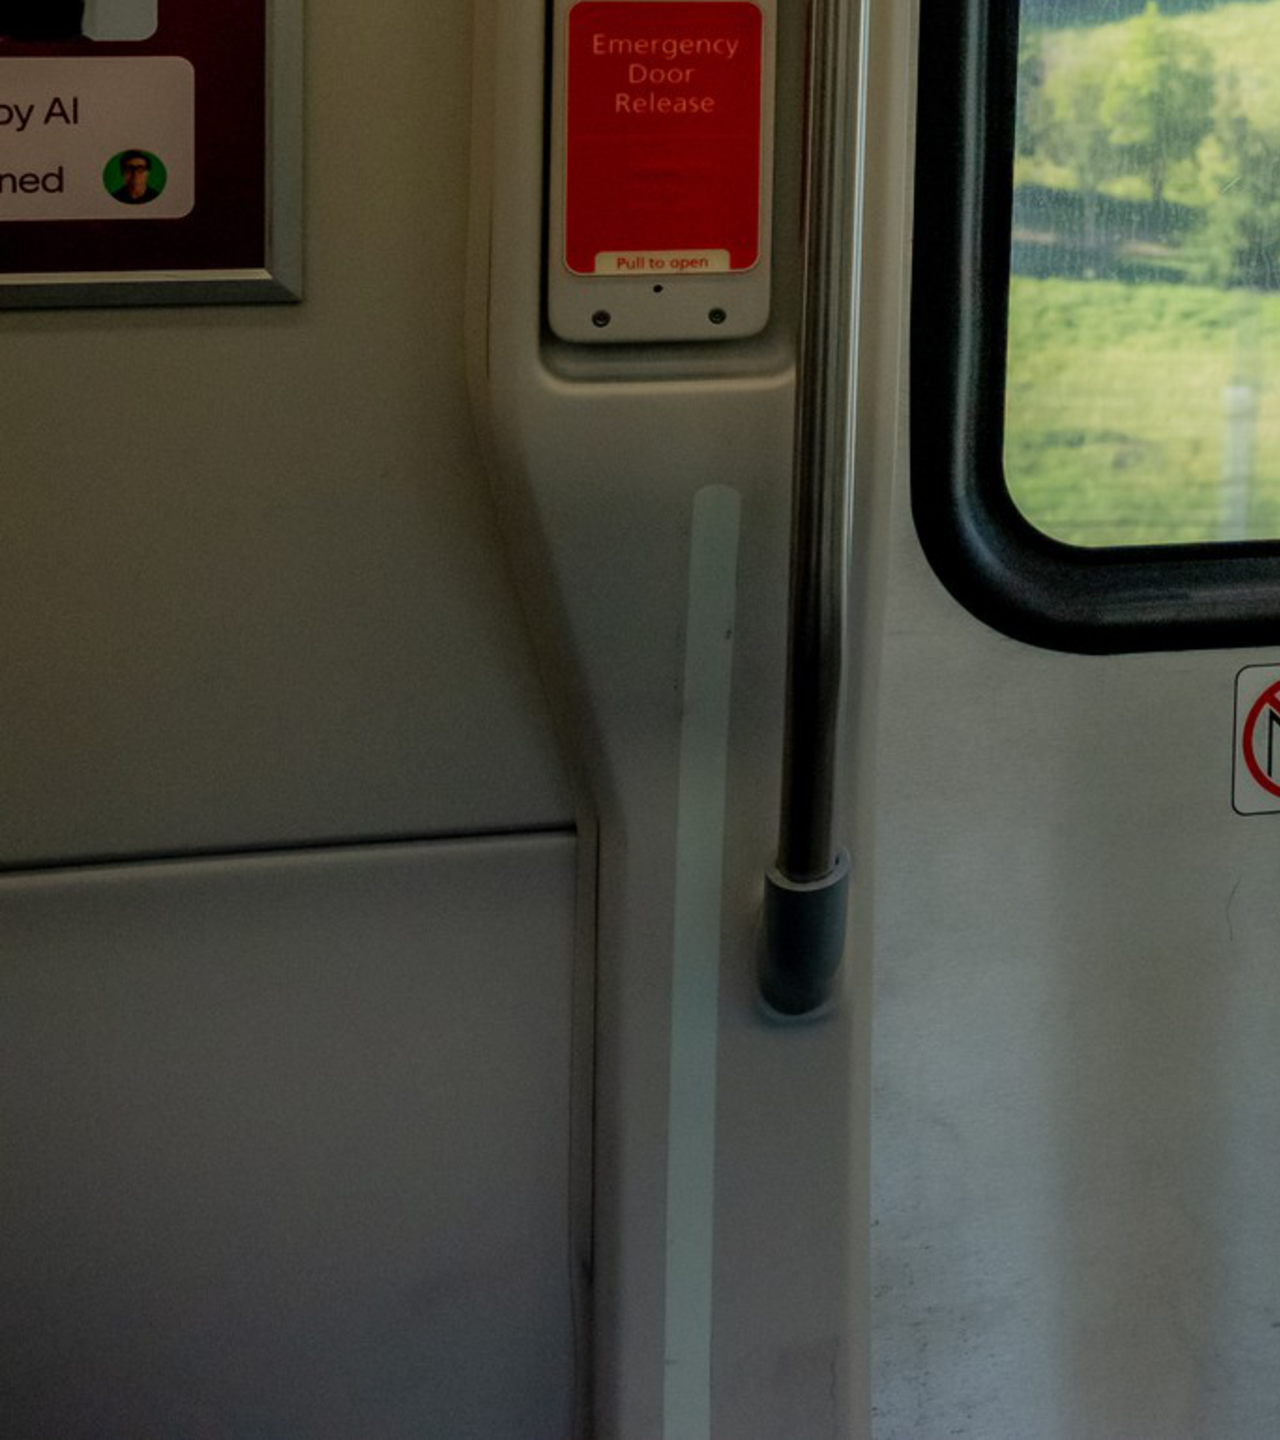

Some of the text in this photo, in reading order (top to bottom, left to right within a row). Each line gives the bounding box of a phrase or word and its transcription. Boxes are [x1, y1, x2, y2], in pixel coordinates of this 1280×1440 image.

[592, 33, 739, 60] Emergency
[628, 63, 697, 84] Door
[615, 91, 716, 114] Release
[616, 257, 709, 271] Pull to open
